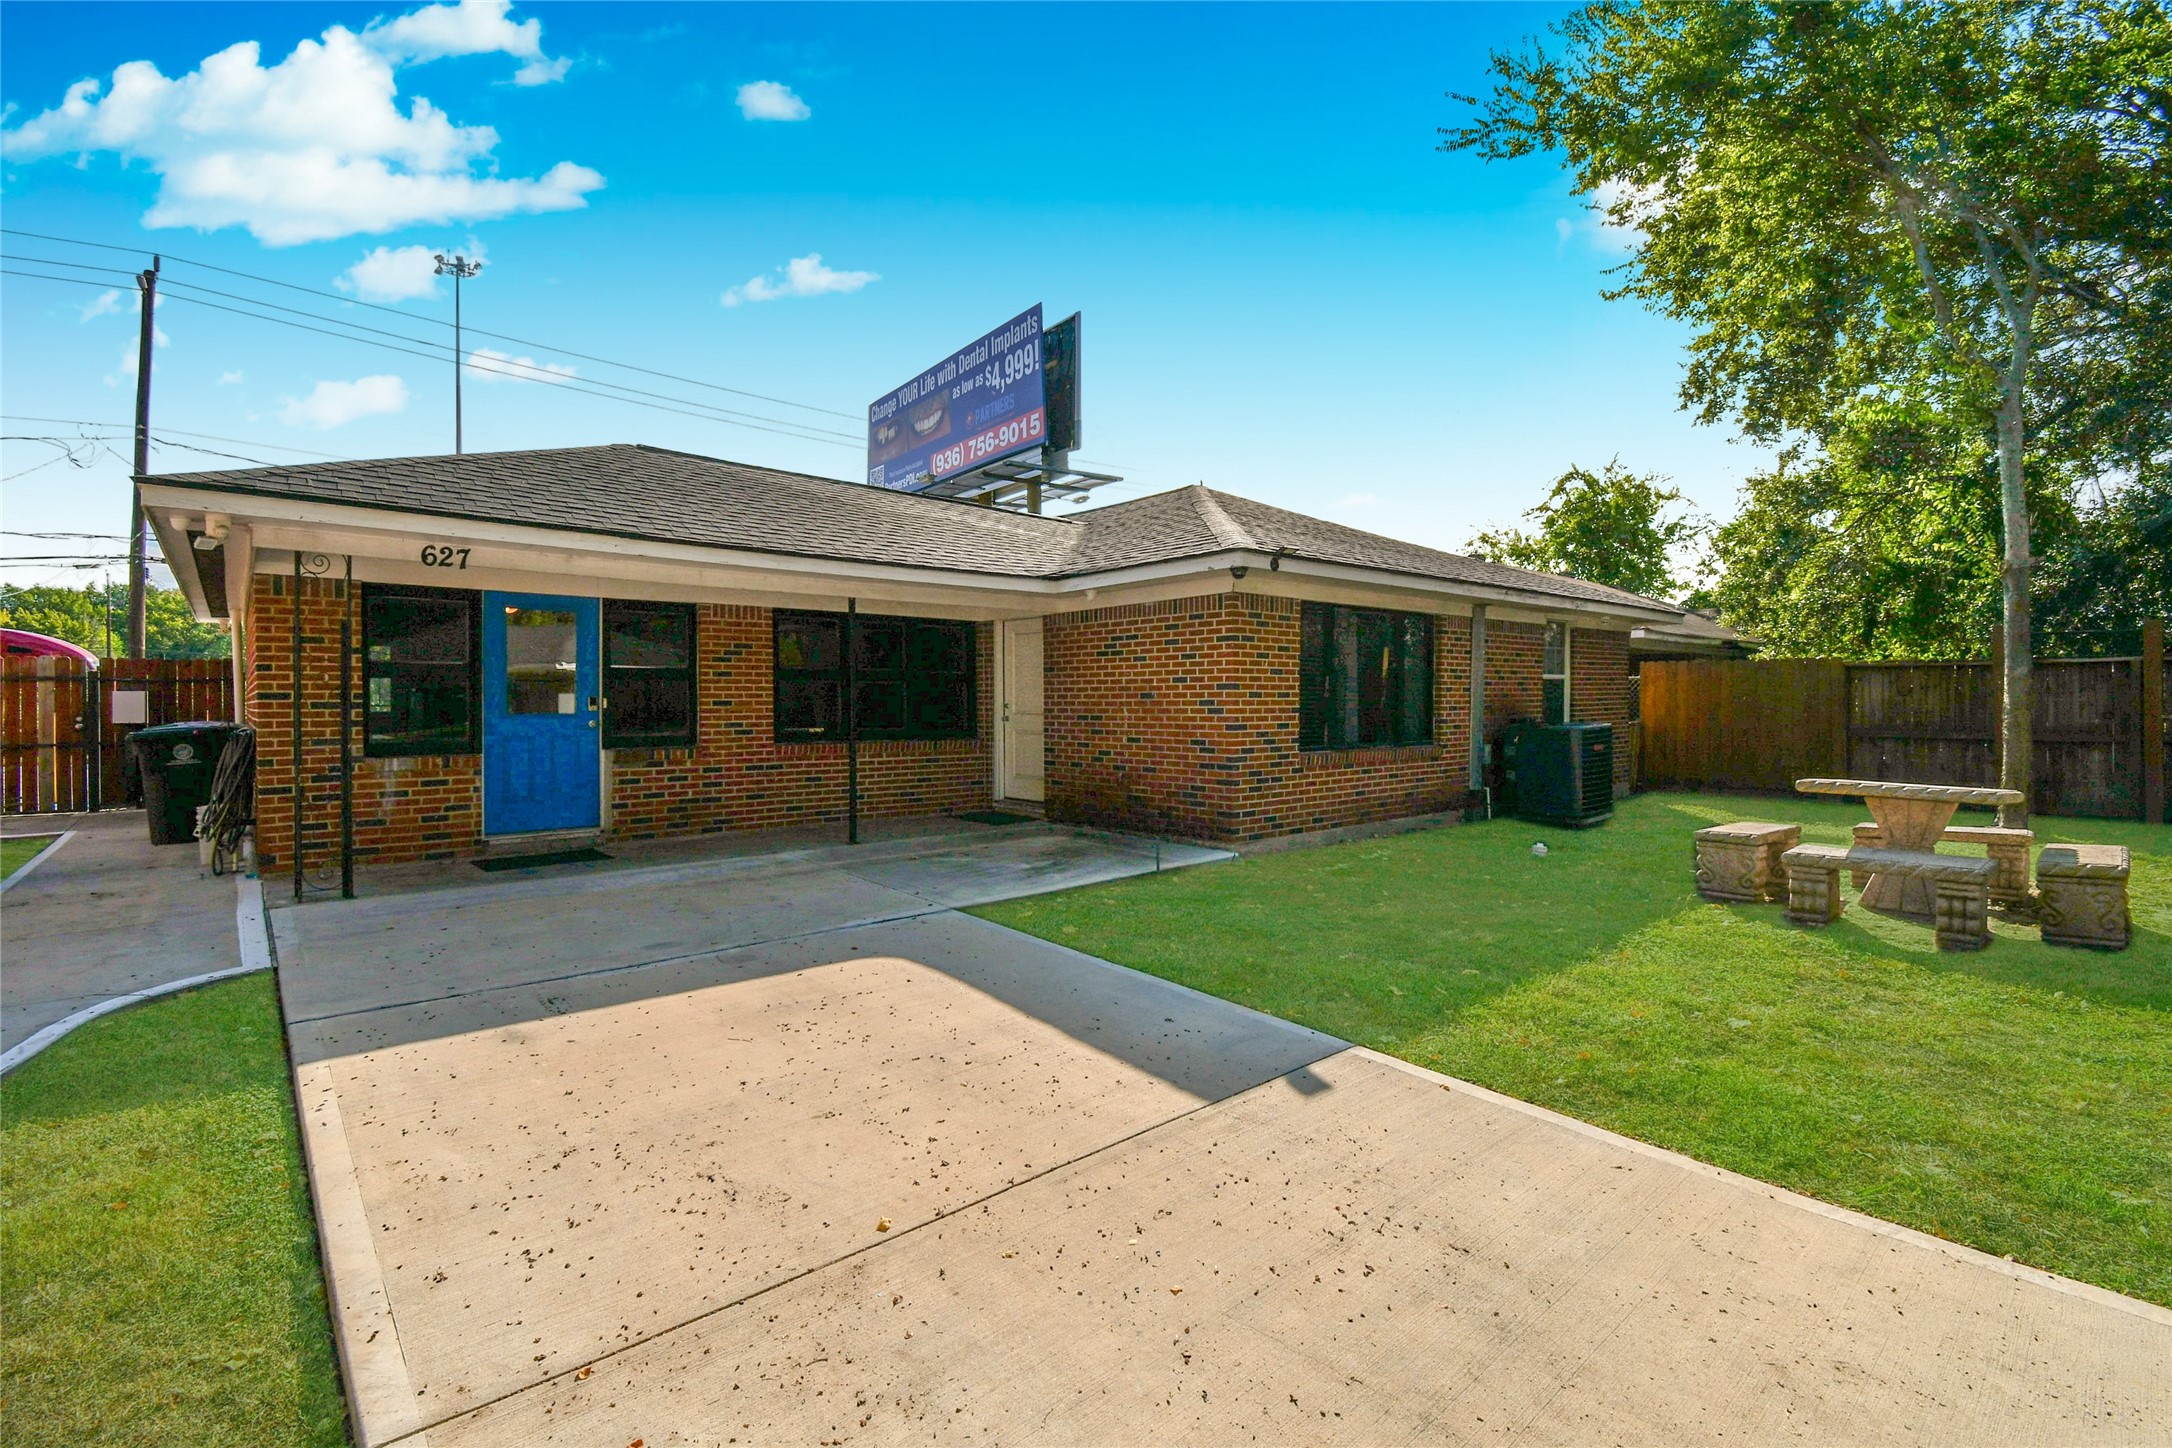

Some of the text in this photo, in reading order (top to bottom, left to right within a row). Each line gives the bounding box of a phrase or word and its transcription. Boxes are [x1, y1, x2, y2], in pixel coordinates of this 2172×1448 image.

[871, 315, 1038, 422] Change YOUR Life with Dental Implants
[952, 338, 1040, 399] as low as $4,999!
[974, 393, 1015, 425] PARTNERS
[932, 443, 964, 475] (936)
[968, 412, 1040, 459] 756-9015
[421, 544, 471, 569] 627
